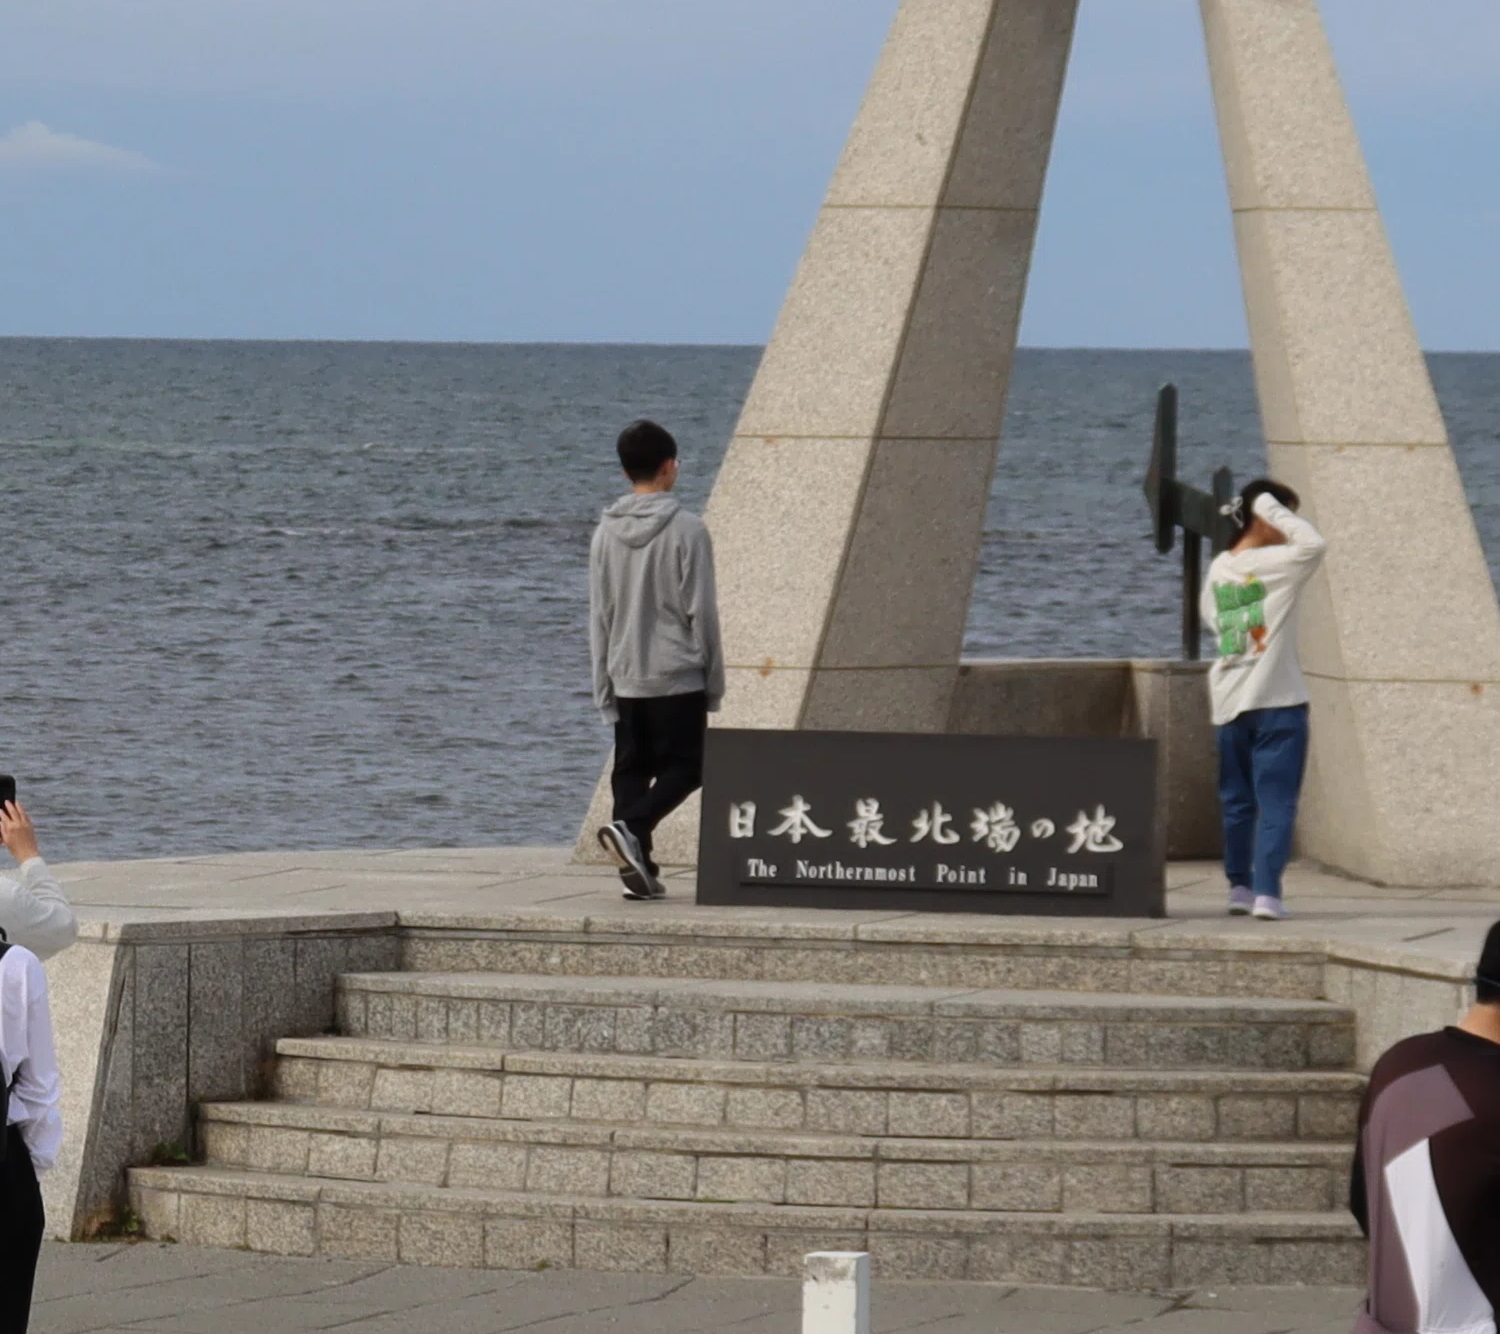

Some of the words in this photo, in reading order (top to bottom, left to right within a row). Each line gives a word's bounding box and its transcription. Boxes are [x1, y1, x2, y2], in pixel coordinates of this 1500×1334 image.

[729, 794, 1124, 854] 日本最北端の地
[747, 858, 777, 878] The
[796, 860, 916, 882] Northernmost
[936, 864, 986, 884] Point
[1009, 867, 1028, 885] in
[1047, 867, 1098, 890] Japan
